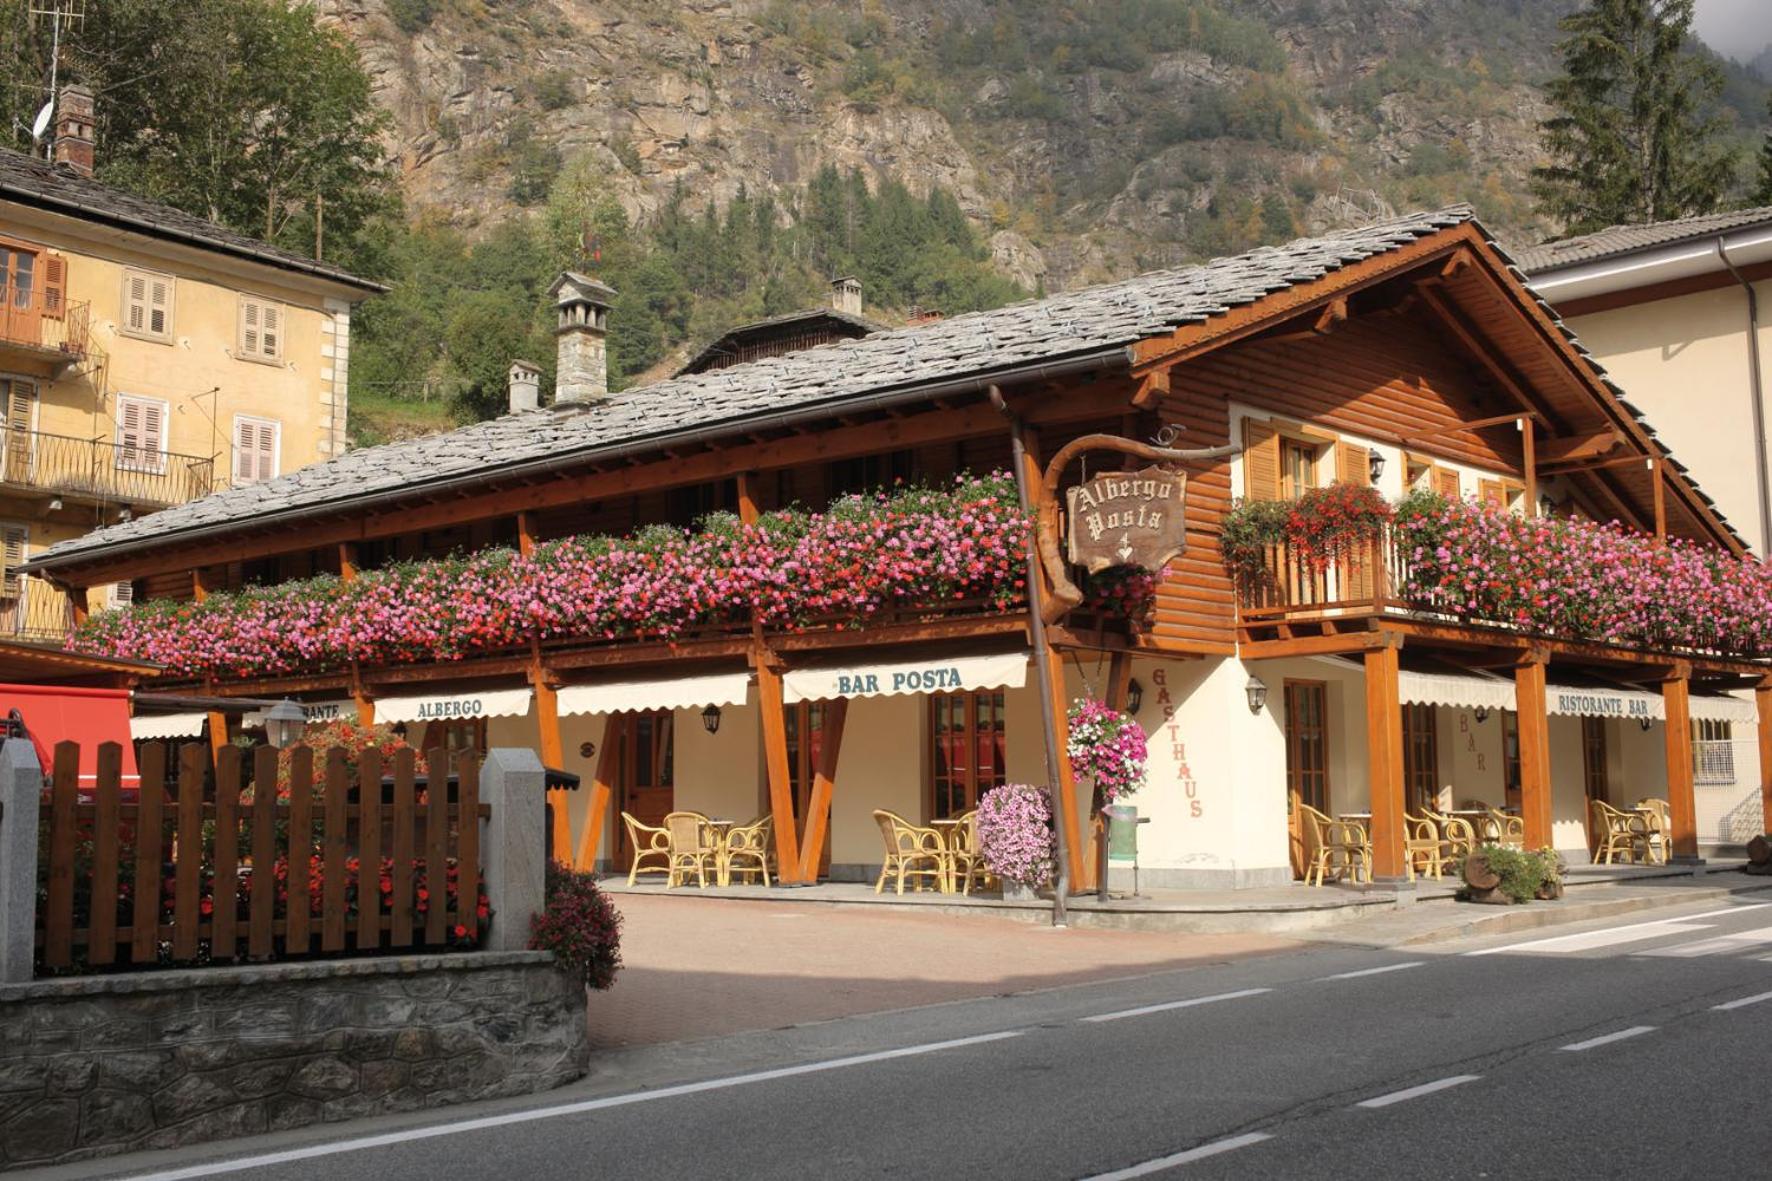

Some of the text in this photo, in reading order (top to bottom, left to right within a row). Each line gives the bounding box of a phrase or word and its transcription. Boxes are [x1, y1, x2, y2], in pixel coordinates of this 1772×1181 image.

[1080, 478, 1172, 513] Albergo
[1086, 504, 1162, 541] Posta
[838, 667, 962, 694] BAR POSTA
[302, 704, 339, 718] RANTE
[418, 699, 482, 717] ALBERGO
[1559, 695, 1648, 714] RISTORANTE BAR
[1152, 668, 1203, 818] GASTHAUS
[1460, 713, 1486, 771] BAR
